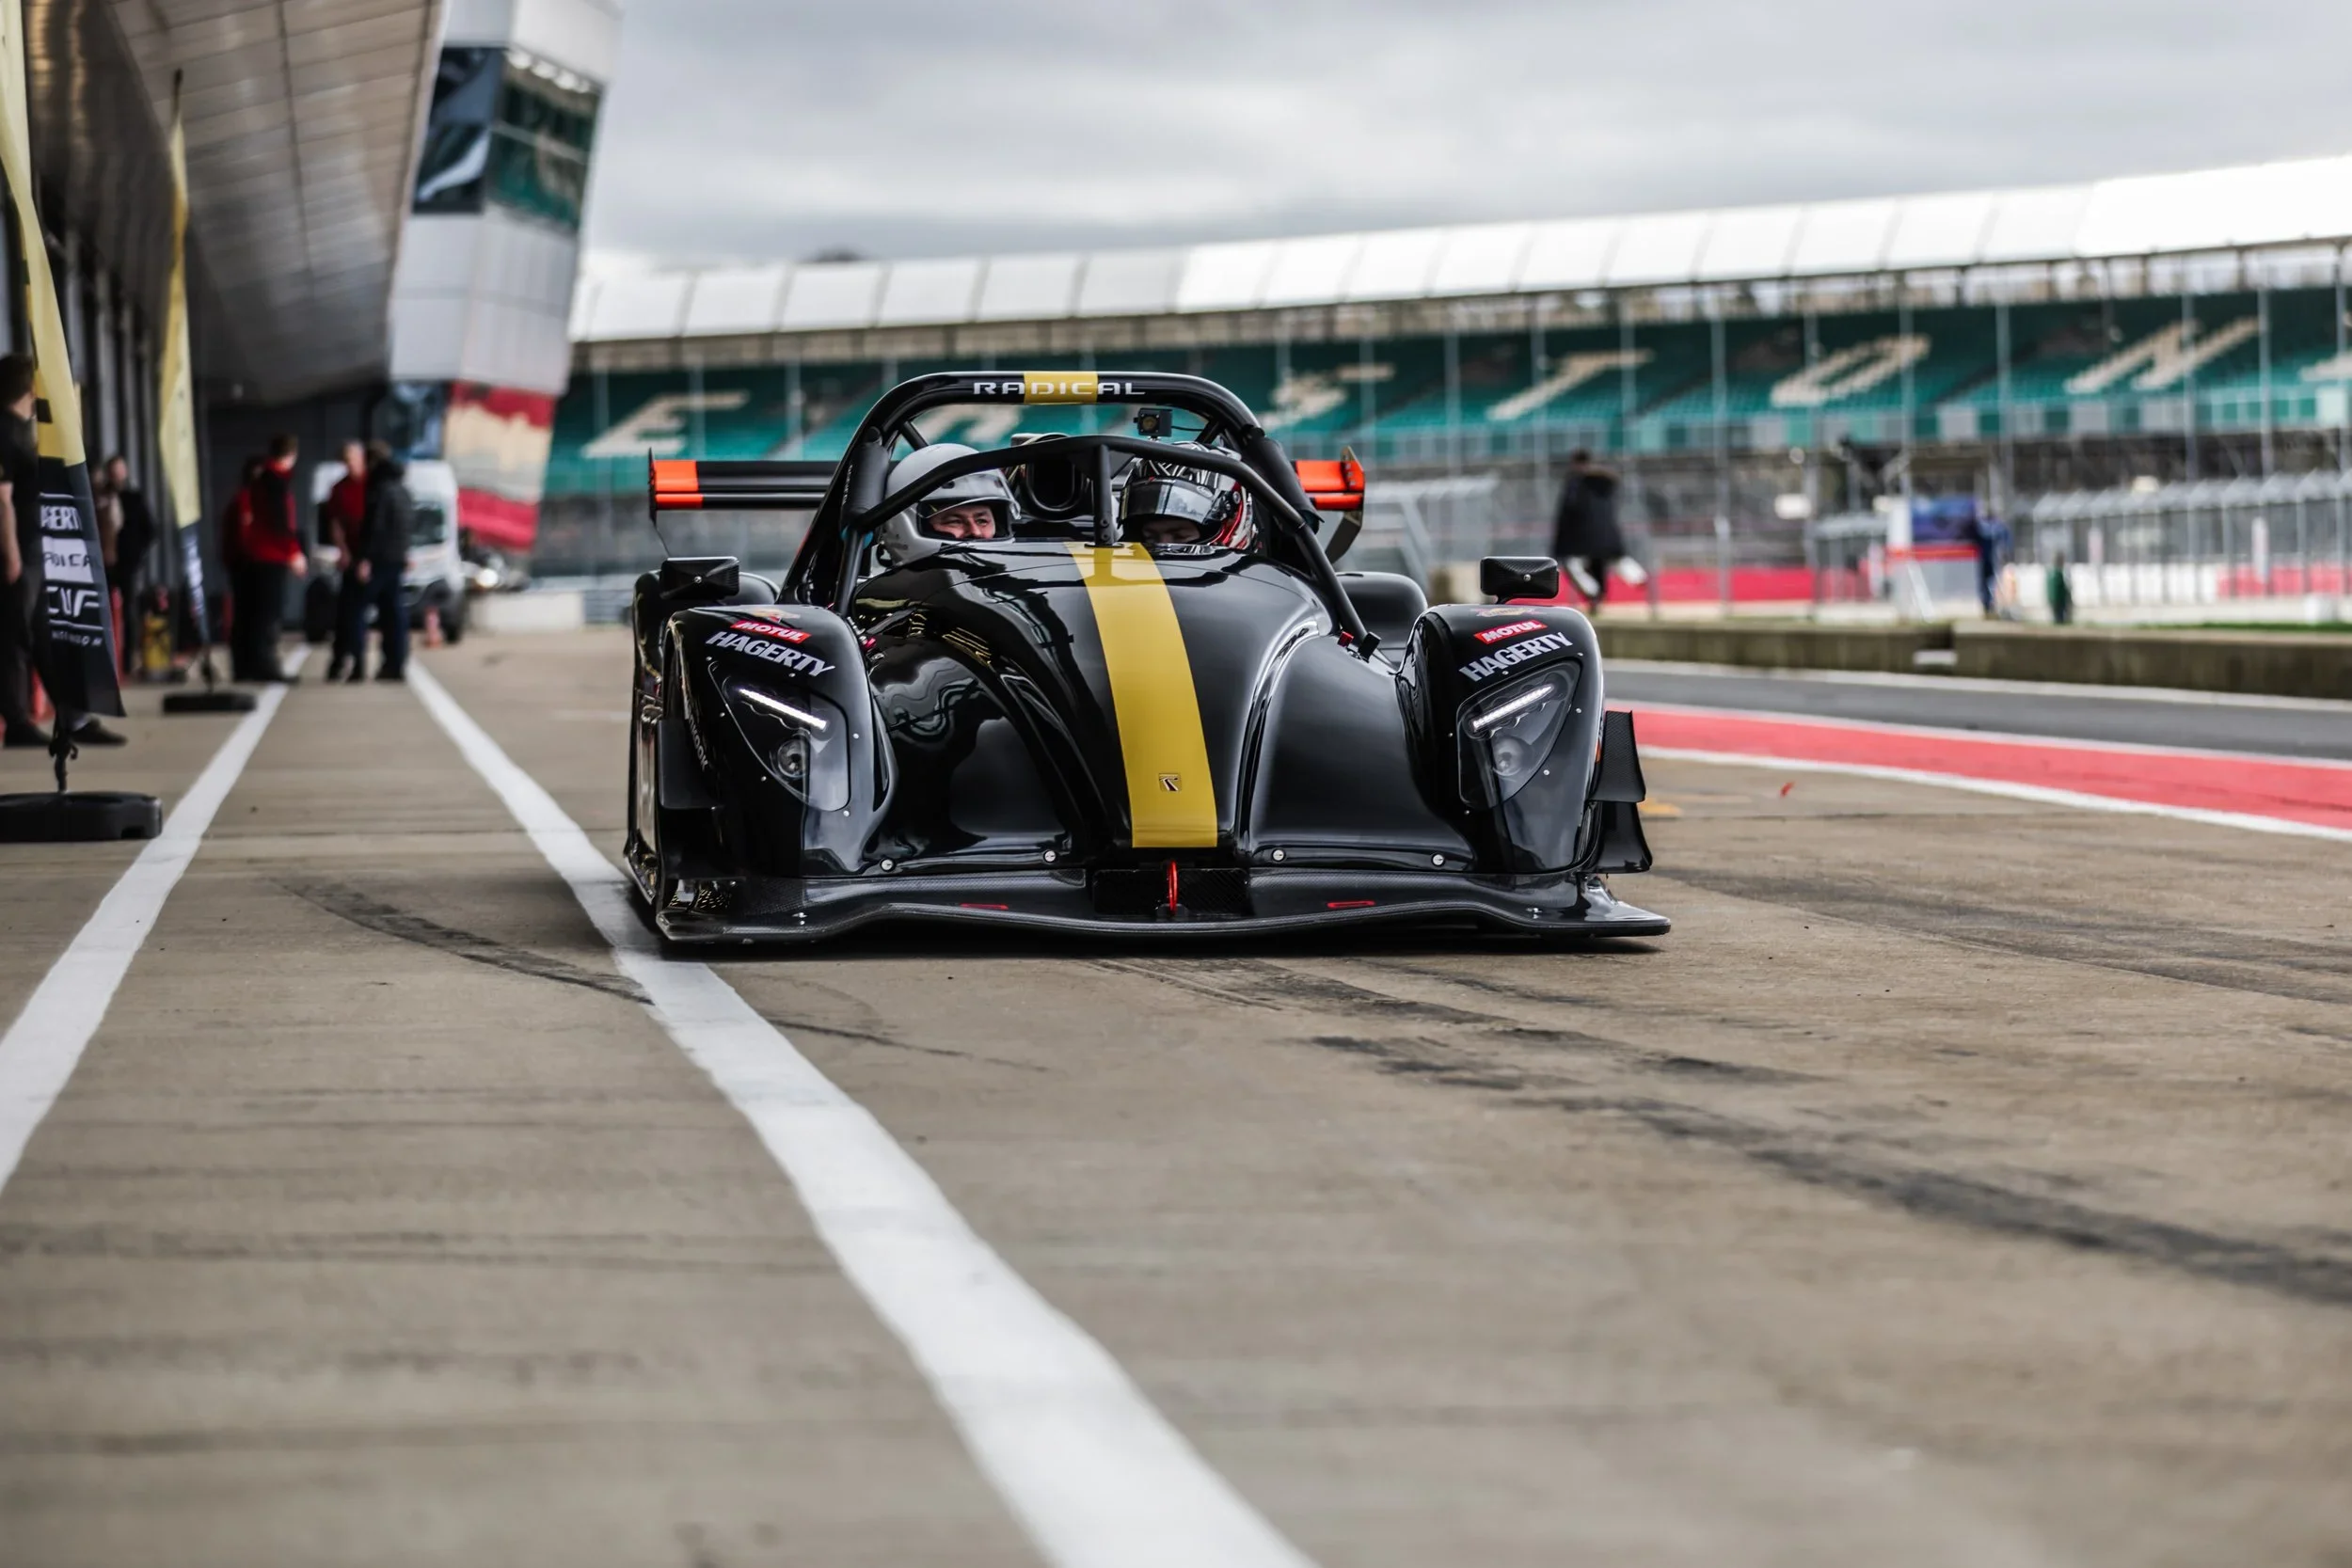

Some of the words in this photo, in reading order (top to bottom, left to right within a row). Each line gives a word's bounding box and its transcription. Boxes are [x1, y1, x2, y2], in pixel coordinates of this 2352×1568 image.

[973, 382, 1146, 395] RADICAL
[736, 622, 803, 641] MOTUL
[1481, 621, 1544, 642] MOTUL
[706, 631, 836, 677] HAGERTY
[1458, 631, 1574, 682] HAGERTY
